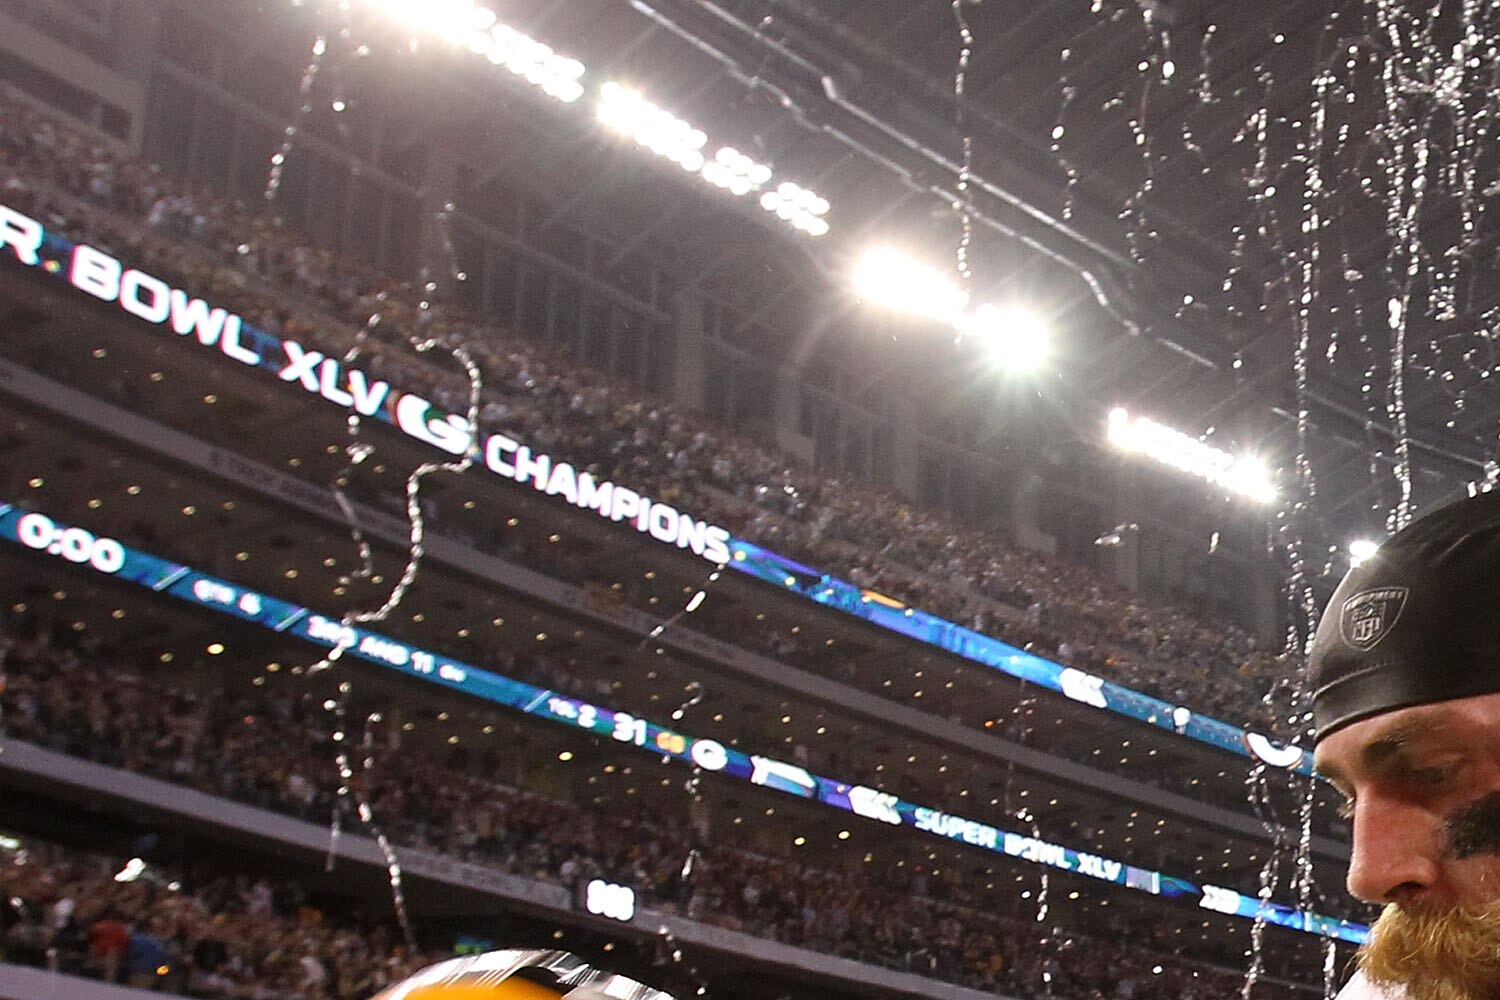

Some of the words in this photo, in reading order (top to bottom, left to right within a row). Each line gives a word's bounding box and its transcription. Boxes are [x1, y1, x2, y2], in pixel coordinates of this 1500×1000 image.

[69, 244, 260, 366] BOWL
[279, 340, 389, 416] XLV
[485, 434, 731, 564] CHAMPIONS
[17, 513, 126, 573] 0:00
[612, 712, 648, 746] 31
[913, 806, 997, 849] SUPER
[1003, 832, 1073, 871] BOWL
[1077, 851, 1123, 882] XLV
